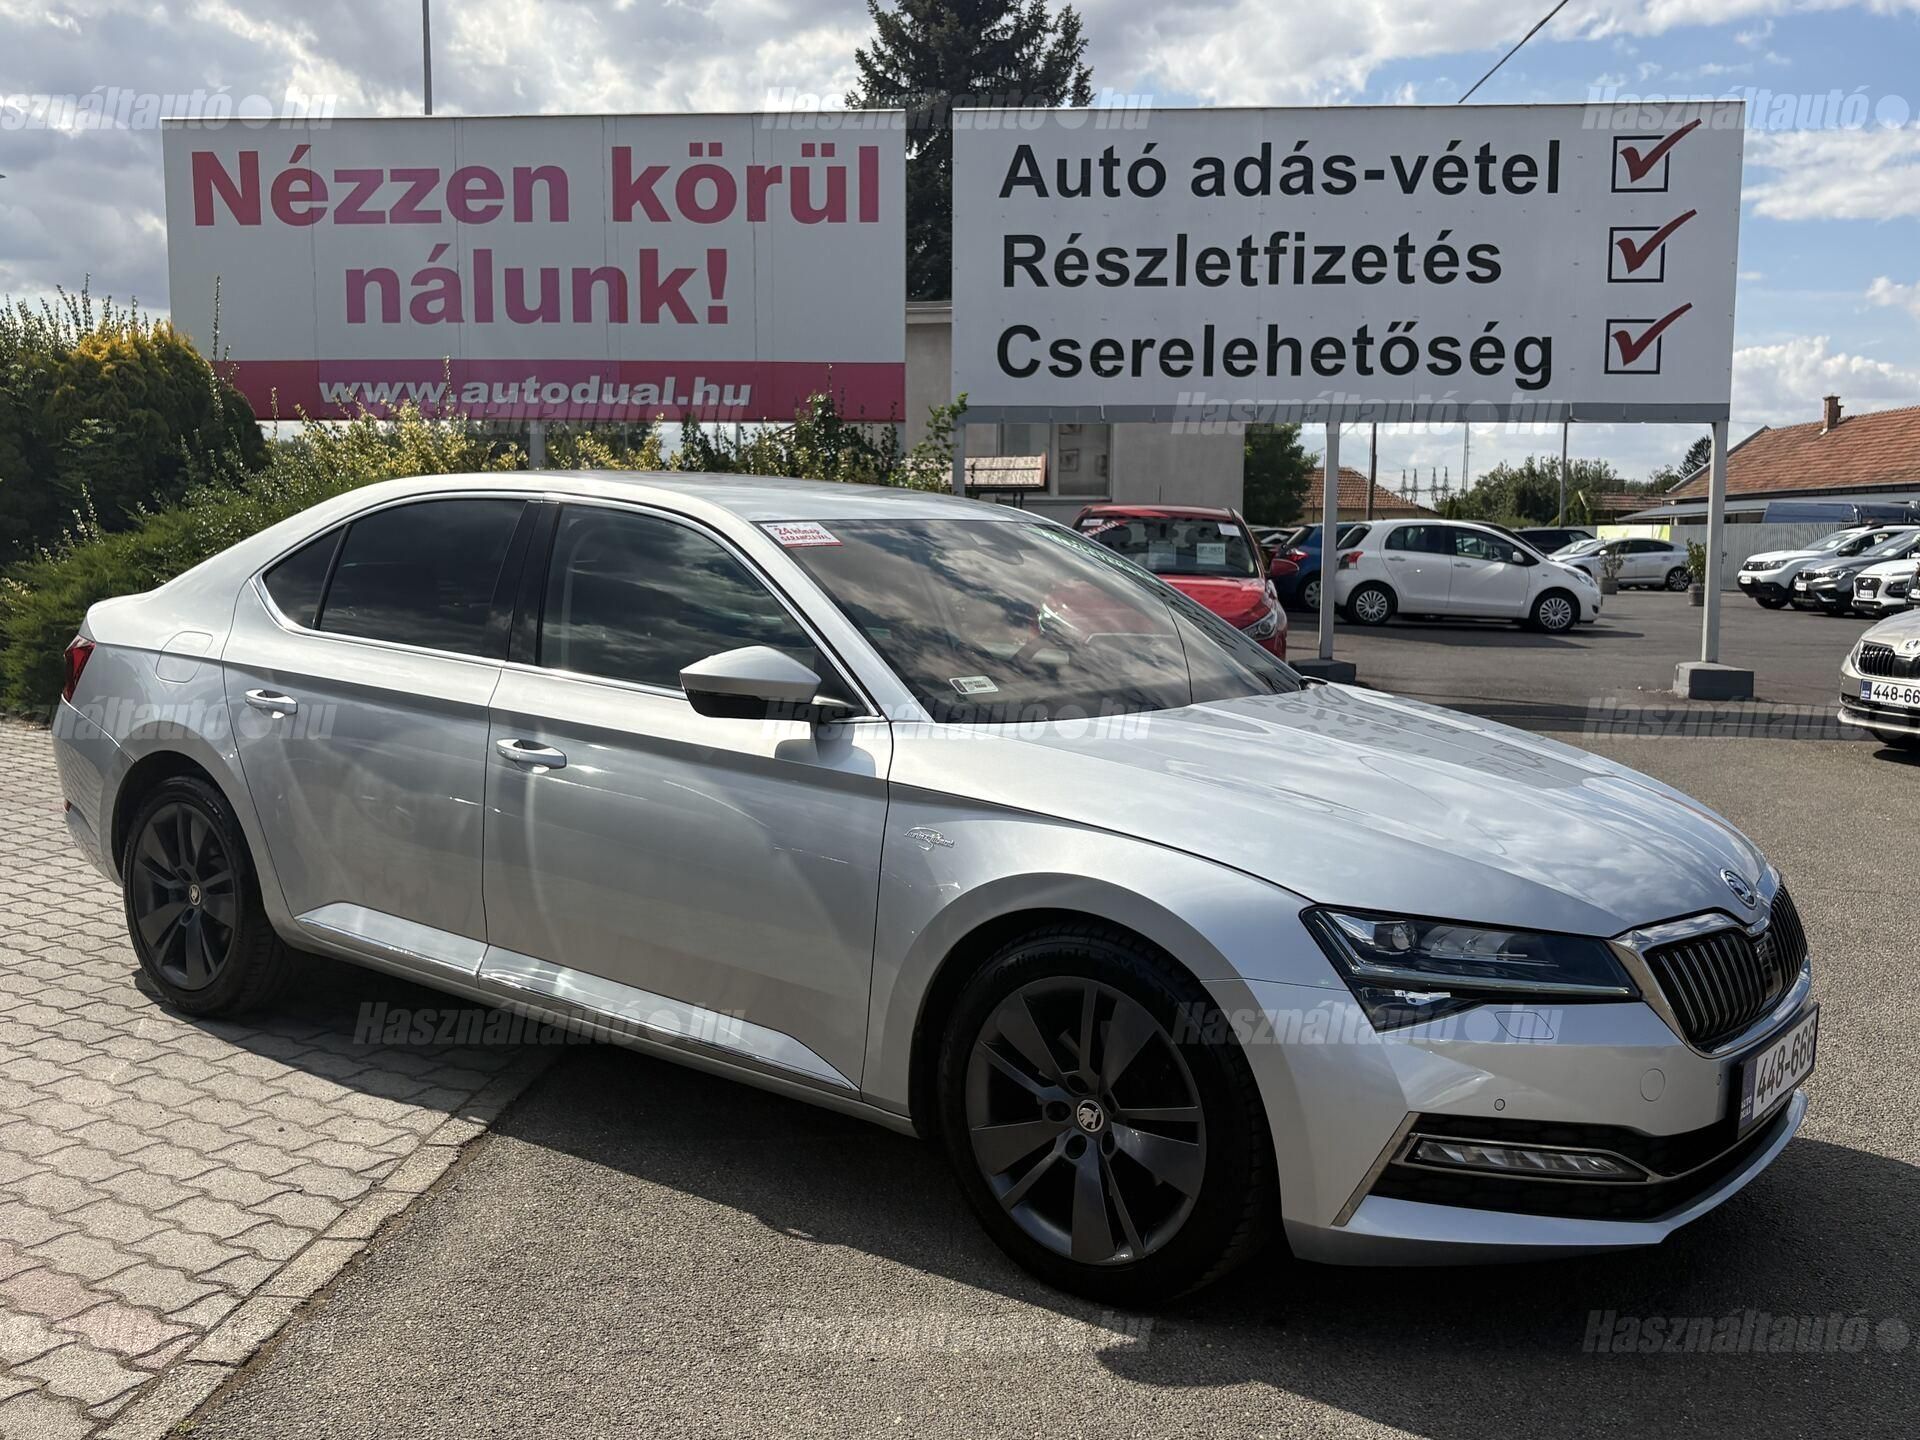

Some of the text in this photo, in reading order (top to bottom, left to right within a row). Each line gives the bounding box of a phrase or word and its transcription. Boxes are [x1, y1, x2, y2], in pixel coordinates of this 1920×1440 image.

[191, 142, 879, 226] Nézzen körül
[998, 139, 1561, 198] Autó adás-vétel
[344, 243, 729, 325] nálunk!
[1002, 229, 1502, 288] Részletfizetés
[996, 320, 1553, 390] Cserelehetőség
[318, 375, 752, 407] www.autodual.hu
[1756, 1019, 1815, 1104] 448-666
